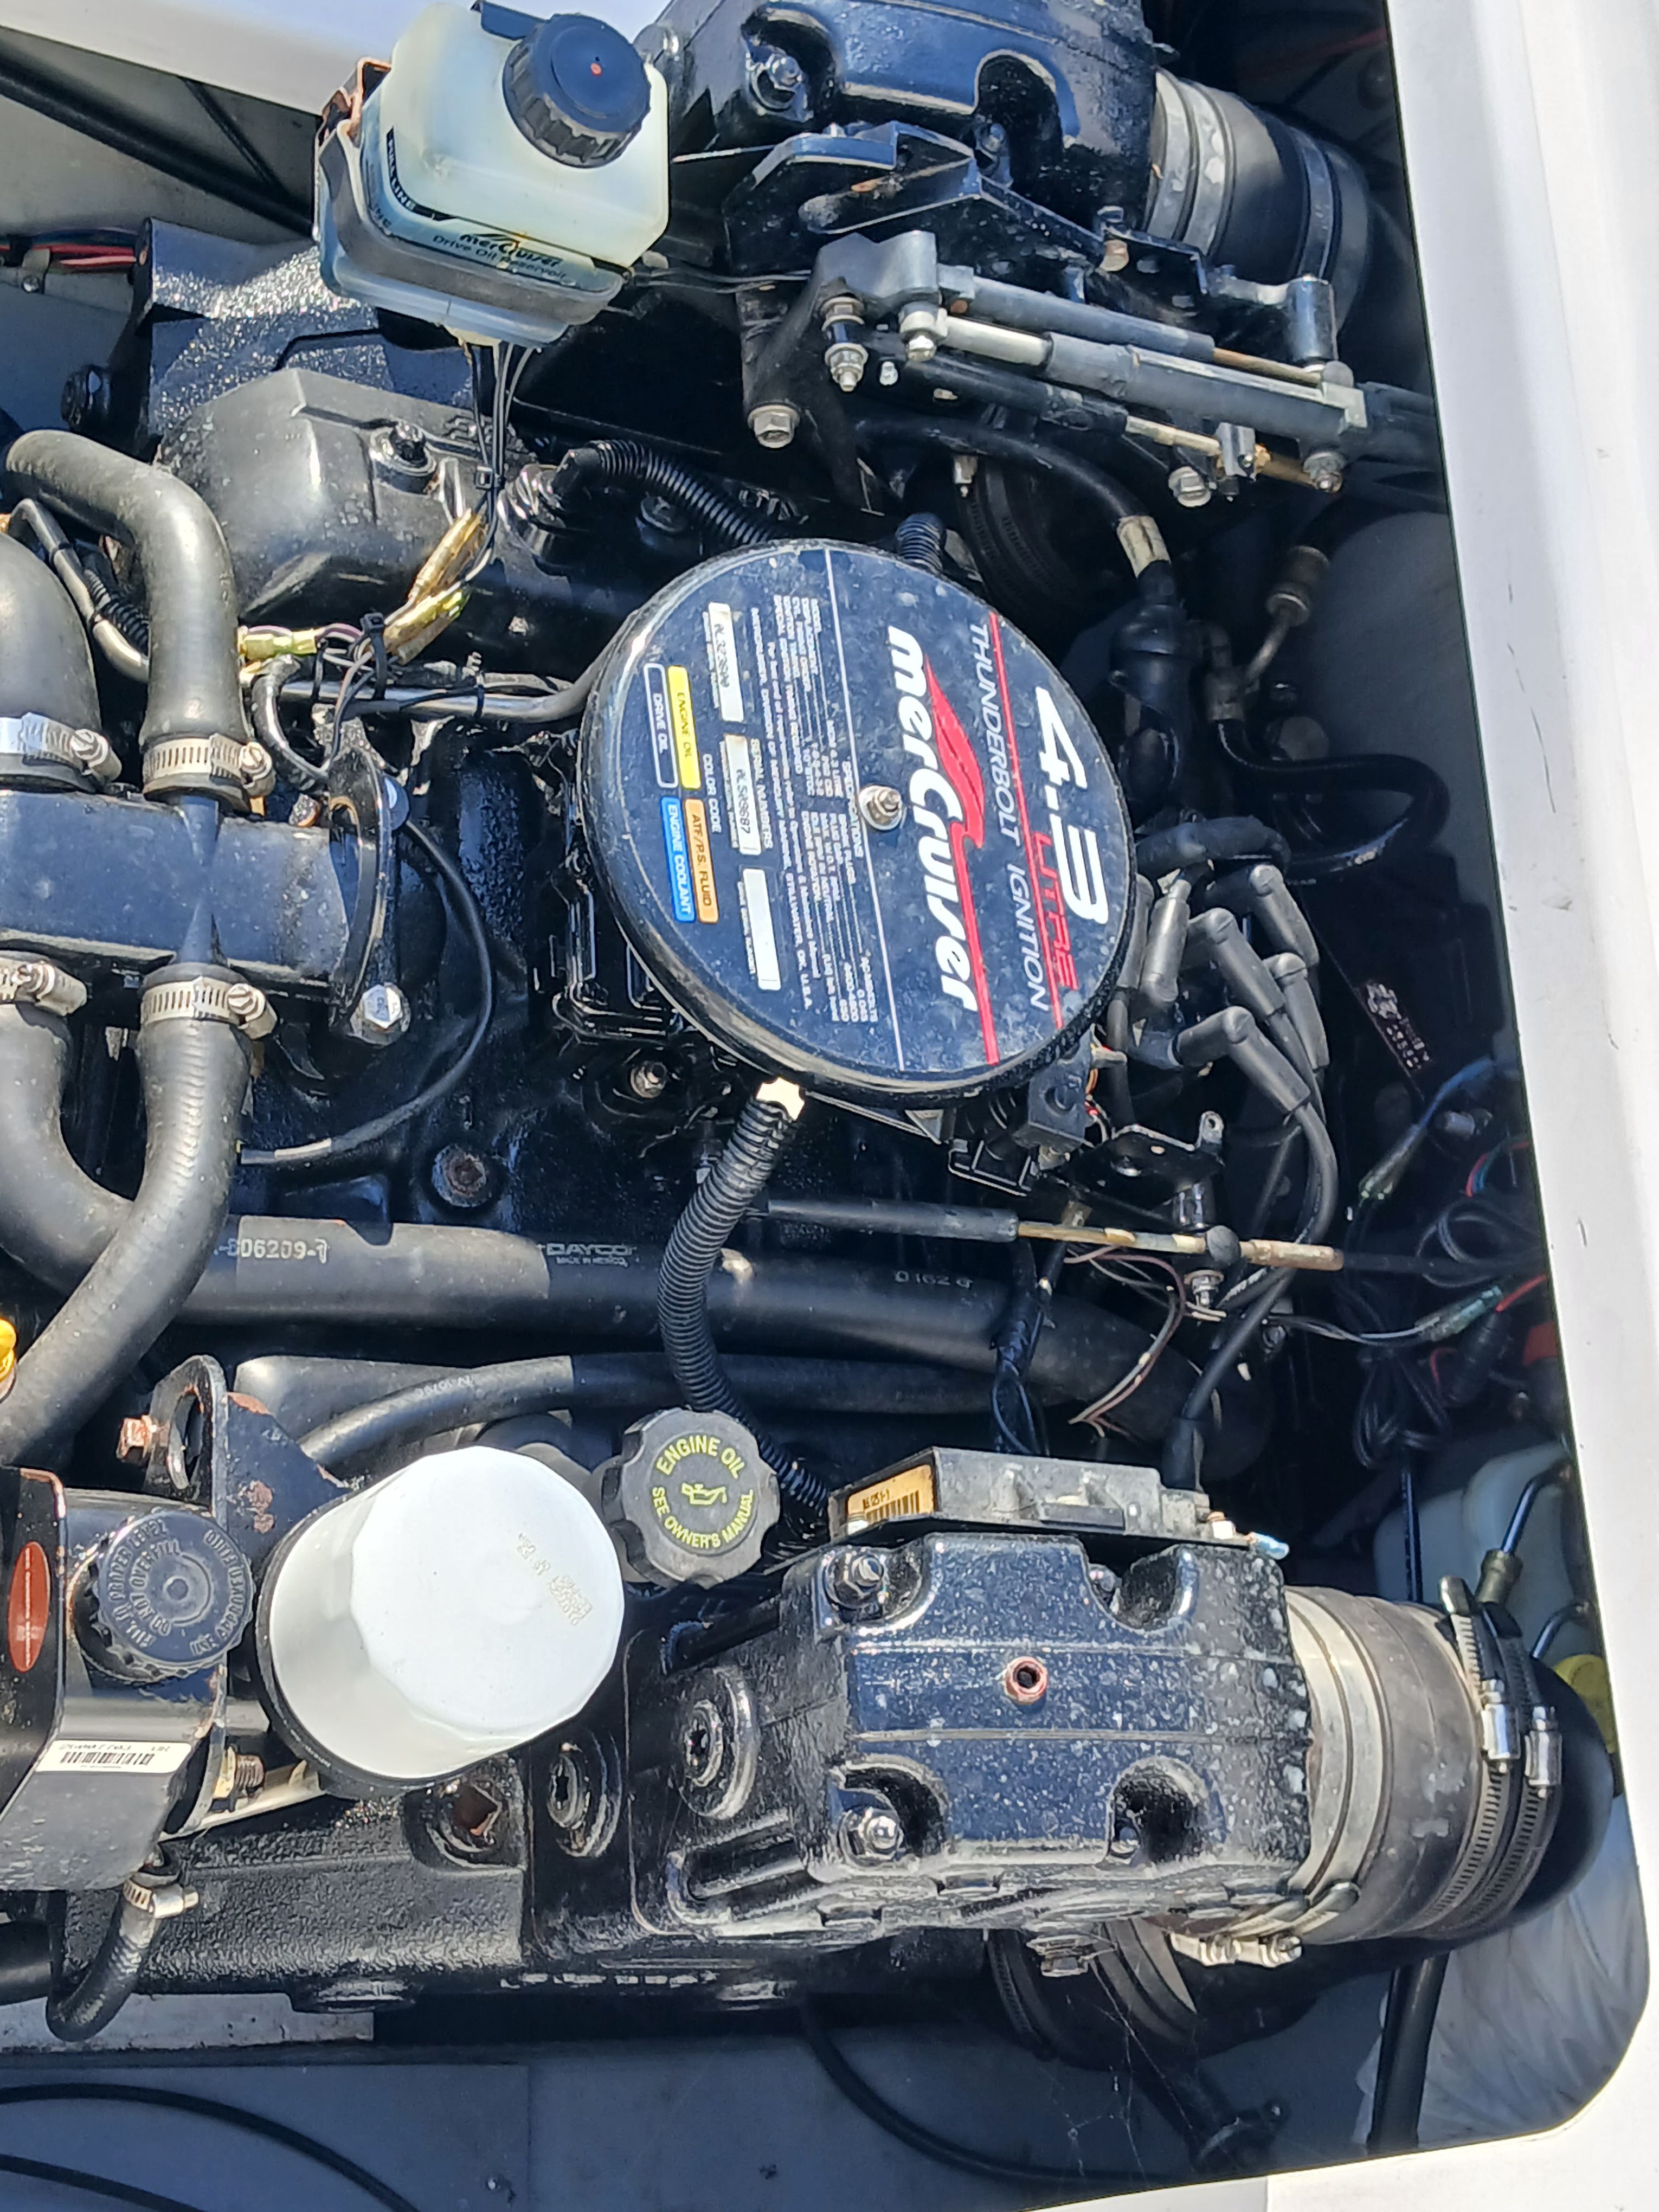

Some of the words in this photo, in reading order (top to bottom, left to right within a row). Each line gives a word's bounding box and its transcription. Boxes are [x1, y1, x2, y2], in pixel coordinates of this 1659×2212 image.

[391, 178, 417, 211] LINE
[433, 235, 472, 251] Drive
[475, 248, 497, 261] Oil
[499, 255, 568, 279] Reservoir
[773, 594, 786, 635] SPECIAL
[811, 598, 821, 634] MODEL
[783, 595, 795, 639] IGNITION
[789, 641, 800, 678] TIMING
[795, 621, 806, 655] FIRING
[779, 638, 791, 682] IGNITION
[800, 656, 811, 692] ORDER
[653, 693, 666, 729] DRIVE
[677, 692, 689, 735] ENGINE
[761, 688, 774, 739] DIVISION
[658, 732, 668, 754] OIL
[750, 738, 764, 781] SERIAL
[768, 741, 776, 757] OF
[790, 721, 803, 774] REQUIRED
[829, 749, 839, 768] 4.3
[702, 754, 716, 795] COLOR
[770, 759, 784, 818] MERCURY
[832, 769, 844, 798] LITRE
[668, 804, 683, 851] ENGINE
[708, 798, 722, 832] CODE
[756, 785, 773, 848] NUMBERS
[829, 813, 840, 841] PLUG
[841, 761, 864, 857] SPECIFICATIONS
[889, 628, 976, 1009] merCruiser
[970, 624, 1020, 845] THUNDERBOLT
[1007, 864, 1049, 1011] IGNITION
[1036, 688, 1108, 924] 4.3
[801, 811, 814, 849] ENGINE
[838, 813, 850, 847] SPARK
[844, 850, 856, 885] PLUGS
[674, 854, 691, 914] COOLANT
[699, 870, 712, 906] FLUID
[807, 851, 821, 902] ROTATION
[820, 876, 834, 923] NEUTRAL
[1033, 832, 1078, 995] LITRE
[546, 1243, 633, 1256] DAYCO
[656, 1435, 721, 1476] ENGINE
[721, 1447, 745, 1480] OIL
[127, 1518, 169, 1548] LEVEL
[652, 1487, 671, 1519] SEE
[664, 1515, 722, 1549] OWNER'S
[722, 1489, 754, 1544] MANUAL
[108, 1545, 133, 1602] PROPER
[128, 1538, 181, 1591] OVERFILL
[113, 1602, 134, 1623] TO
[129, 1592, 156, 1624] NOT
[149, 1617, 172, 1637] DO
[189, 1633, 220, 1657] USE
[215, 1564, 244, 1642] APPROVED
